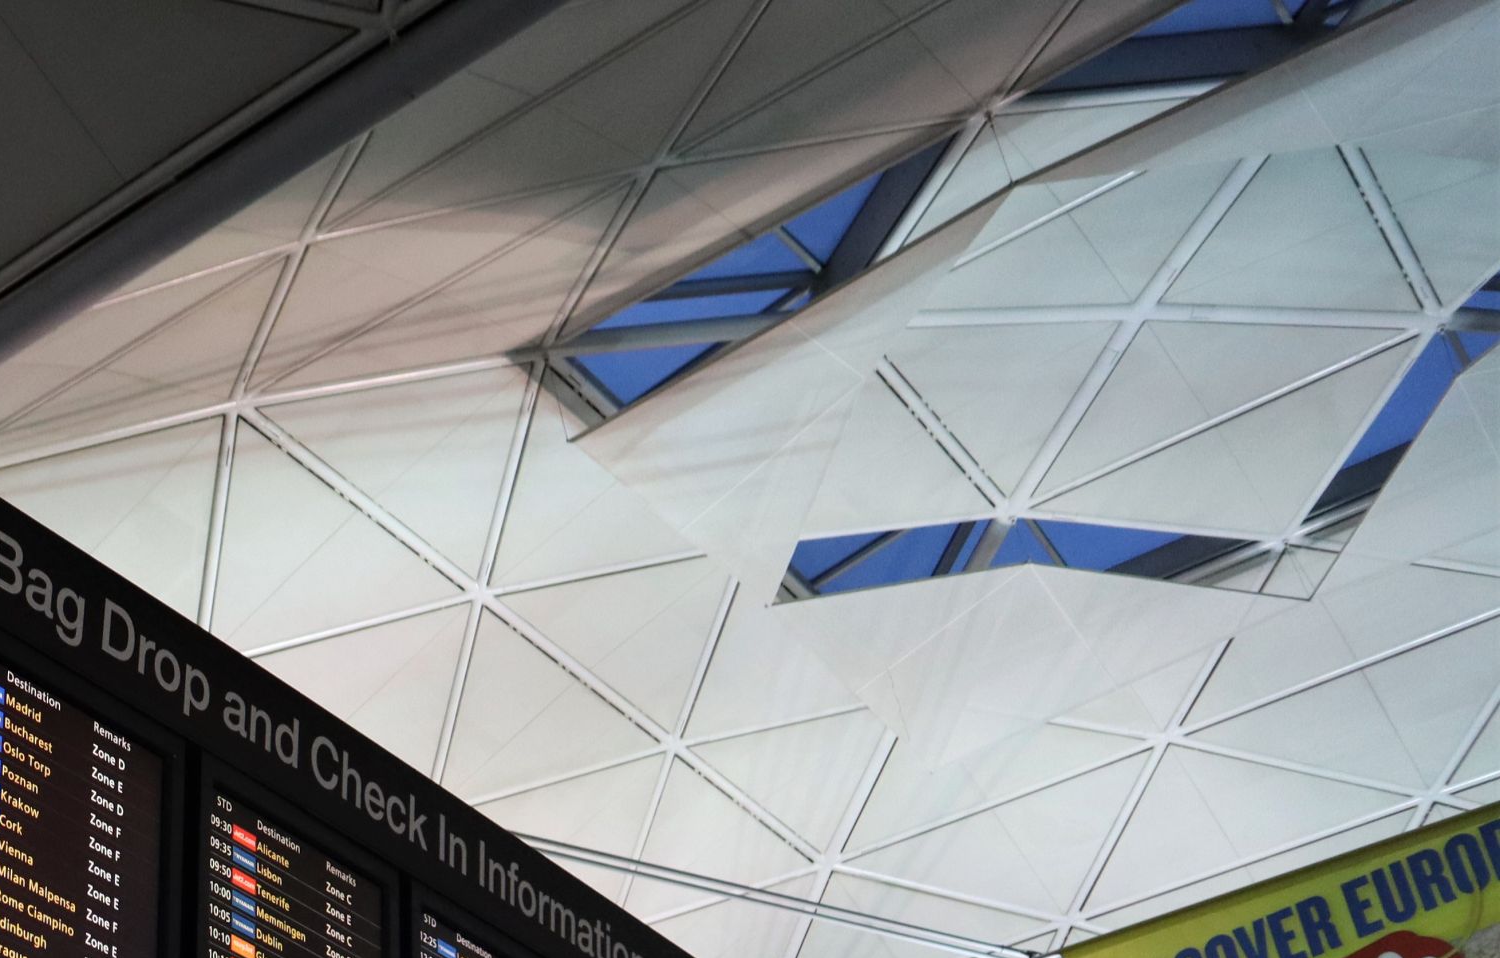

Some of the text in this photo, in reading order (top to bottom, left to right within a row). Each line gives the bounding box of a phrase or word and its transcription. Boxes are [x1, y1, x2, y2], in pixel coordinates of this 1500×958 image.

[5, 692, 41, 723] Madrid
[92, 743, 115, 766] Zone
[118, 757, 125, 770] D
[6, 669, 60, 711] Destination
[93, 720, 130, 751] Remarks
[101, 598, 211, 716] Drop
[222, 690, 300, 769] and
[311, 736, 428, 851] Check
[439, 814, 467, 876] In
[4, 716, 52, 753] Bucharest
[91, 766, 115, 788] Zone
[117, 780, 123, 793] E
[210, 835, 351, 926] 09:35 Lisbon Zone E
[216, 795, 356, 887] STD Destination Remarks
[86, 883, 111, 906] Zone
[113, 897, 119, 910] E
